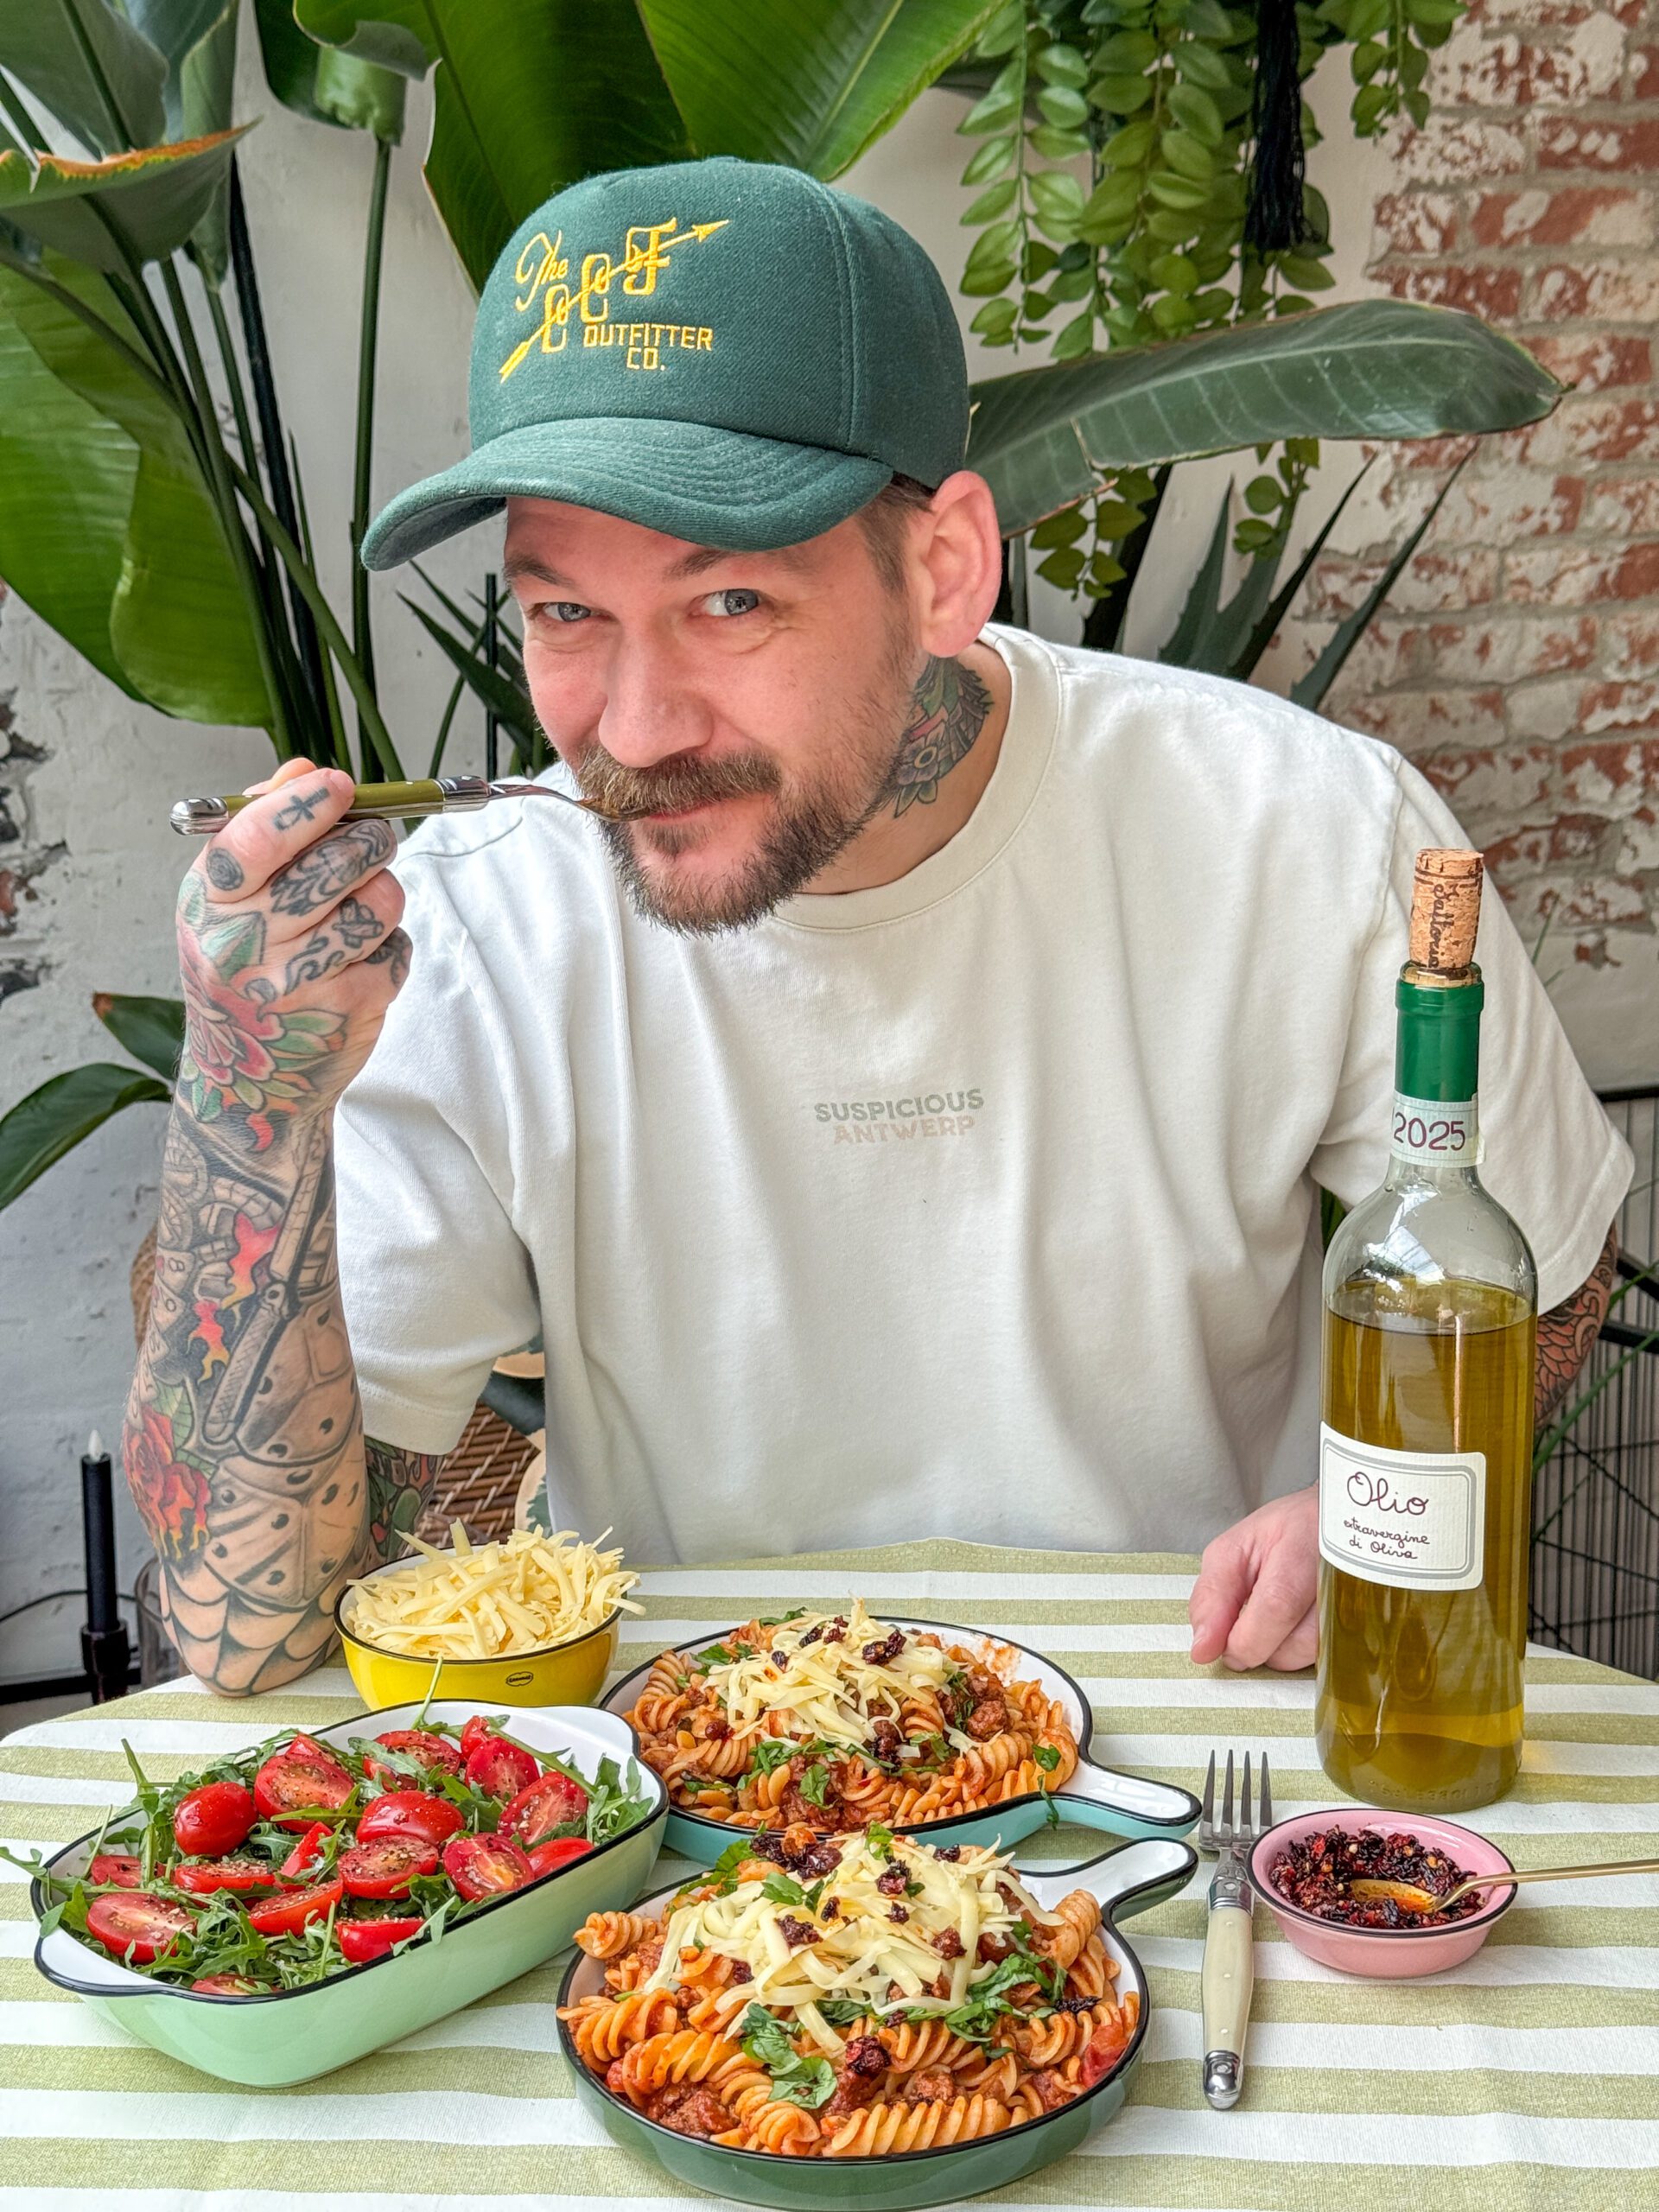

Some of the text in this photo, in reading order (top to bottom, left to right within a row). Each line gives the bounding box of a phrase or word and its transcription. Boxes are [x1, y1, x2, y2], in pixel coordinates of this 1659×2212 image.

[515, 230, 569, 312] The
[582, 322, 714, 352] OUTFITTER
[626, 346, 665, 371] CO.
[814, 1088, 985, 1122] SUSPICIOUS
[834, 1115, 976, 1145] ANTWERP
[1394, 1111, 1466, 1151] 2025
[1347, 1471, 1429, 1516] Olio
[1349, 1535, 1363, 1549] di
